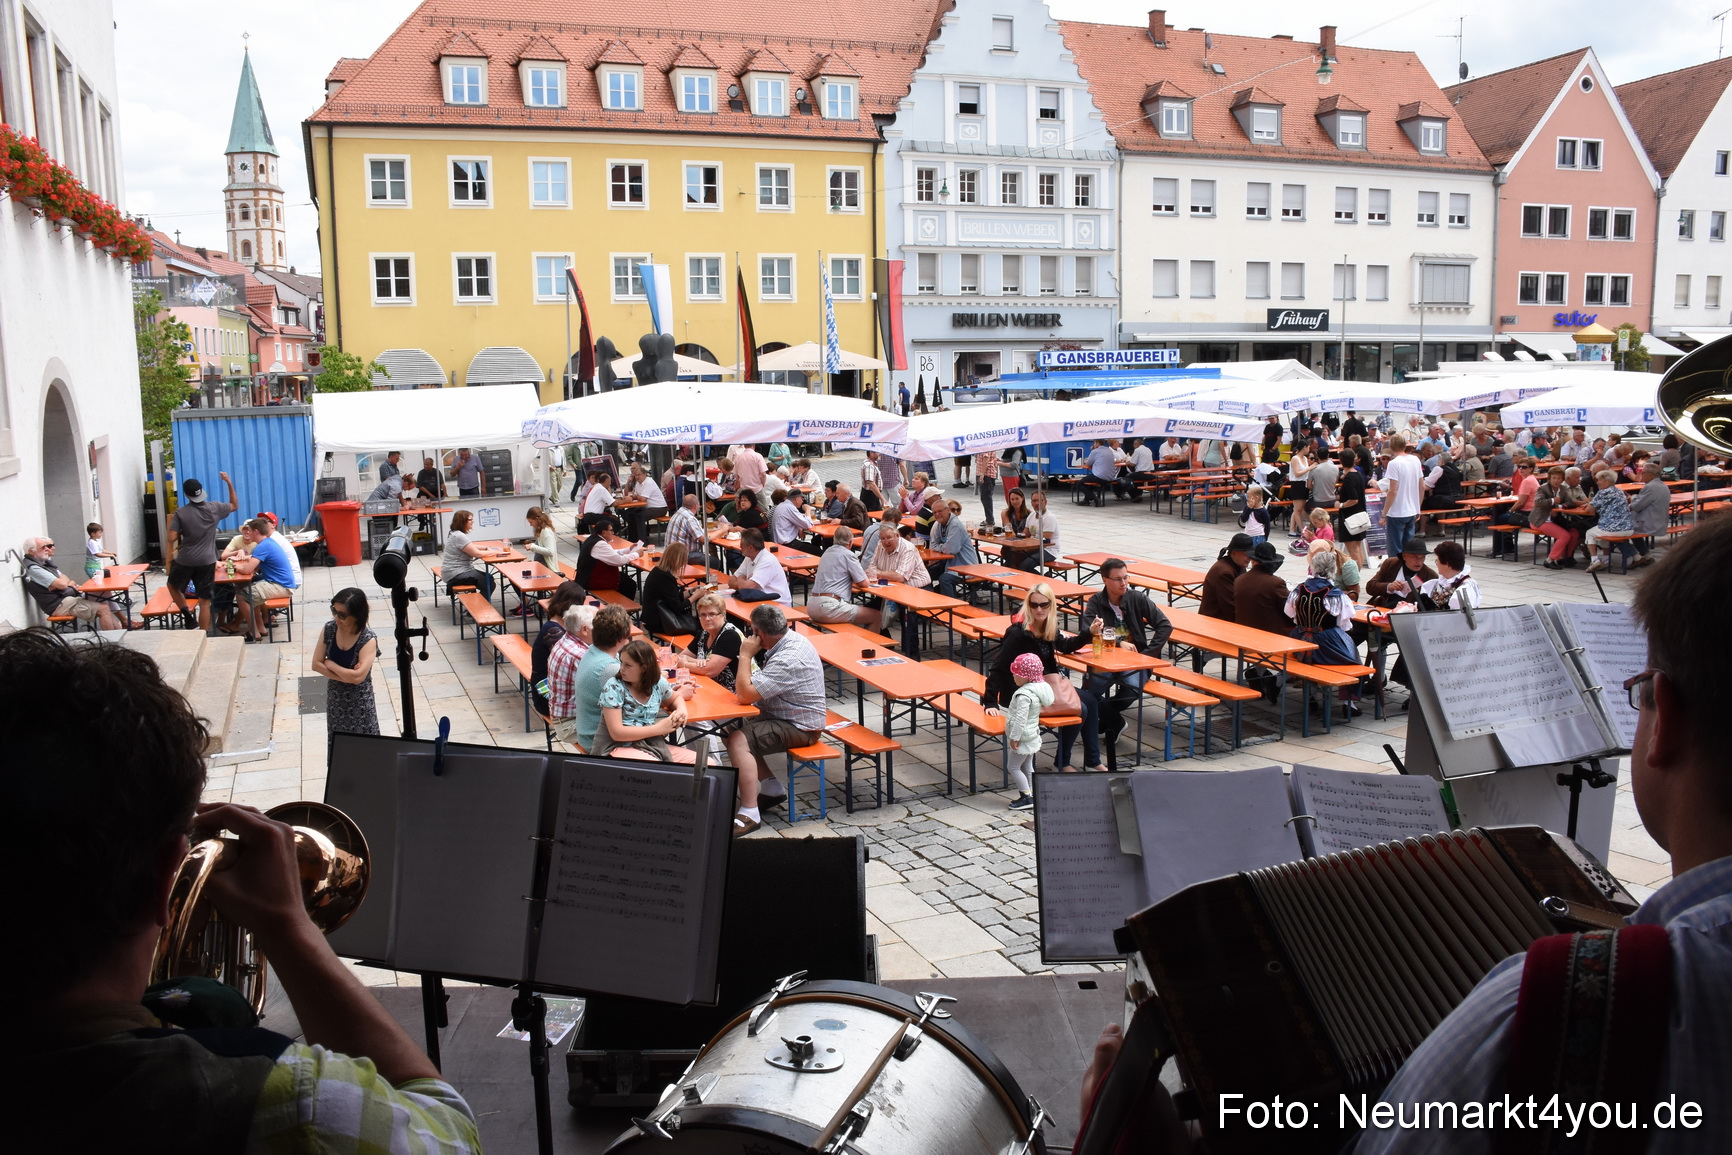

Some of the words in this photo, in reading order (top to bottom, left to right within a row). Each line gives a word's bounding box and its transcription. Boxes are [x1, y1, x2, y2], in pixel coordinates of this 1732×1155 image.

[964, 222, 1011, 235] BRILLEN
[1013, 223, 1057, 236] WEBER
[952, 313, 1008, 327] BRILLEN
[1010, 313, 1063, 327] WEBER
[1270, 310, 1328, 329] frühauf
[1553, 309, 1598, 327] sutor
[1056, 351, 1165, 364] GANSBRAUEREI
